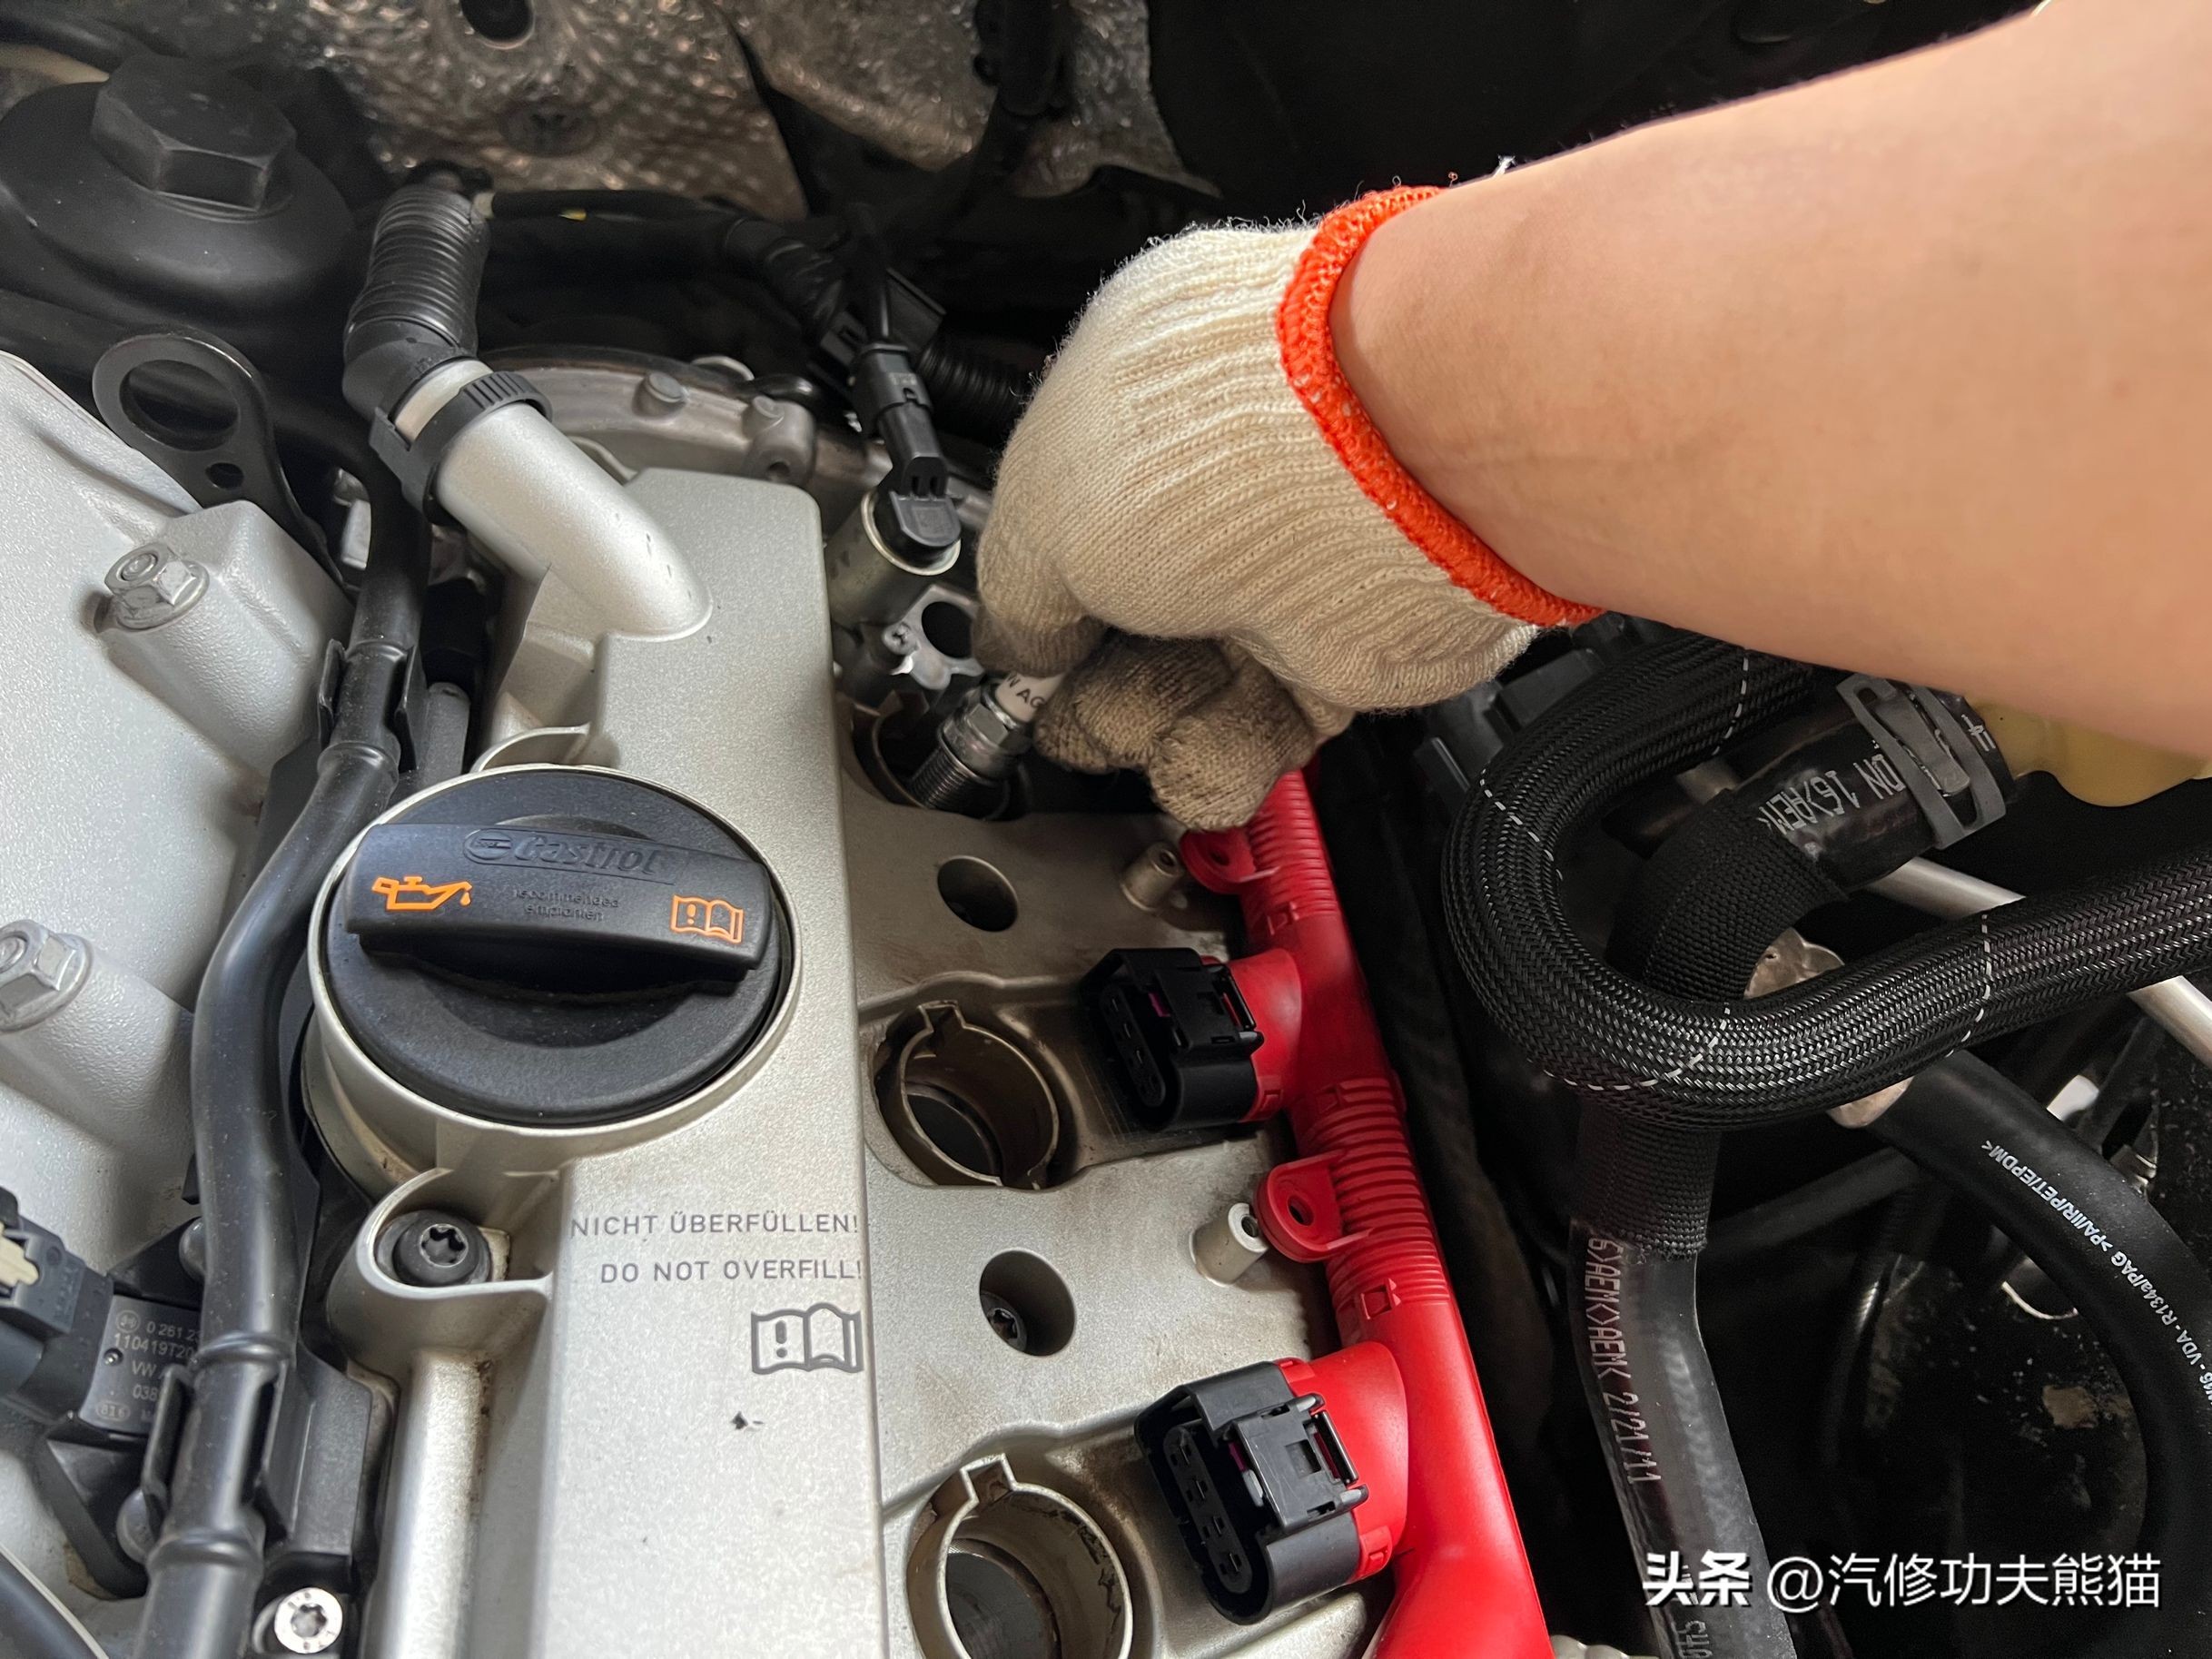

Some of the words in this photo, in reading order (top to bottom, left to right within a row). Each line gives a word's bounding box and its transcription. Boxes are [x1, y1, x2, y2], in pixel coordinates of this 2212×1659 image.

[1852, 754, 1906, 799] DN
[514, 834, 662, 876] Castrol
[571, 1215, 658, 1237] NICHT
[670, 1210, 859, 1234] ÜBERFÜLLEN!
[600, 1263, 637, 1283] DO
[654, 1260, 709, 1281] NOT
[723, 1259, 862, 1280] OVERFILL!
[2111, 1250, 2178, 1326] R134a/PAG
[2176, 1329, 2202, 1365] VDA
[132, 1359, 158, 1378] VW
[1603, 1391, 1662, 1485] 2/21/11
